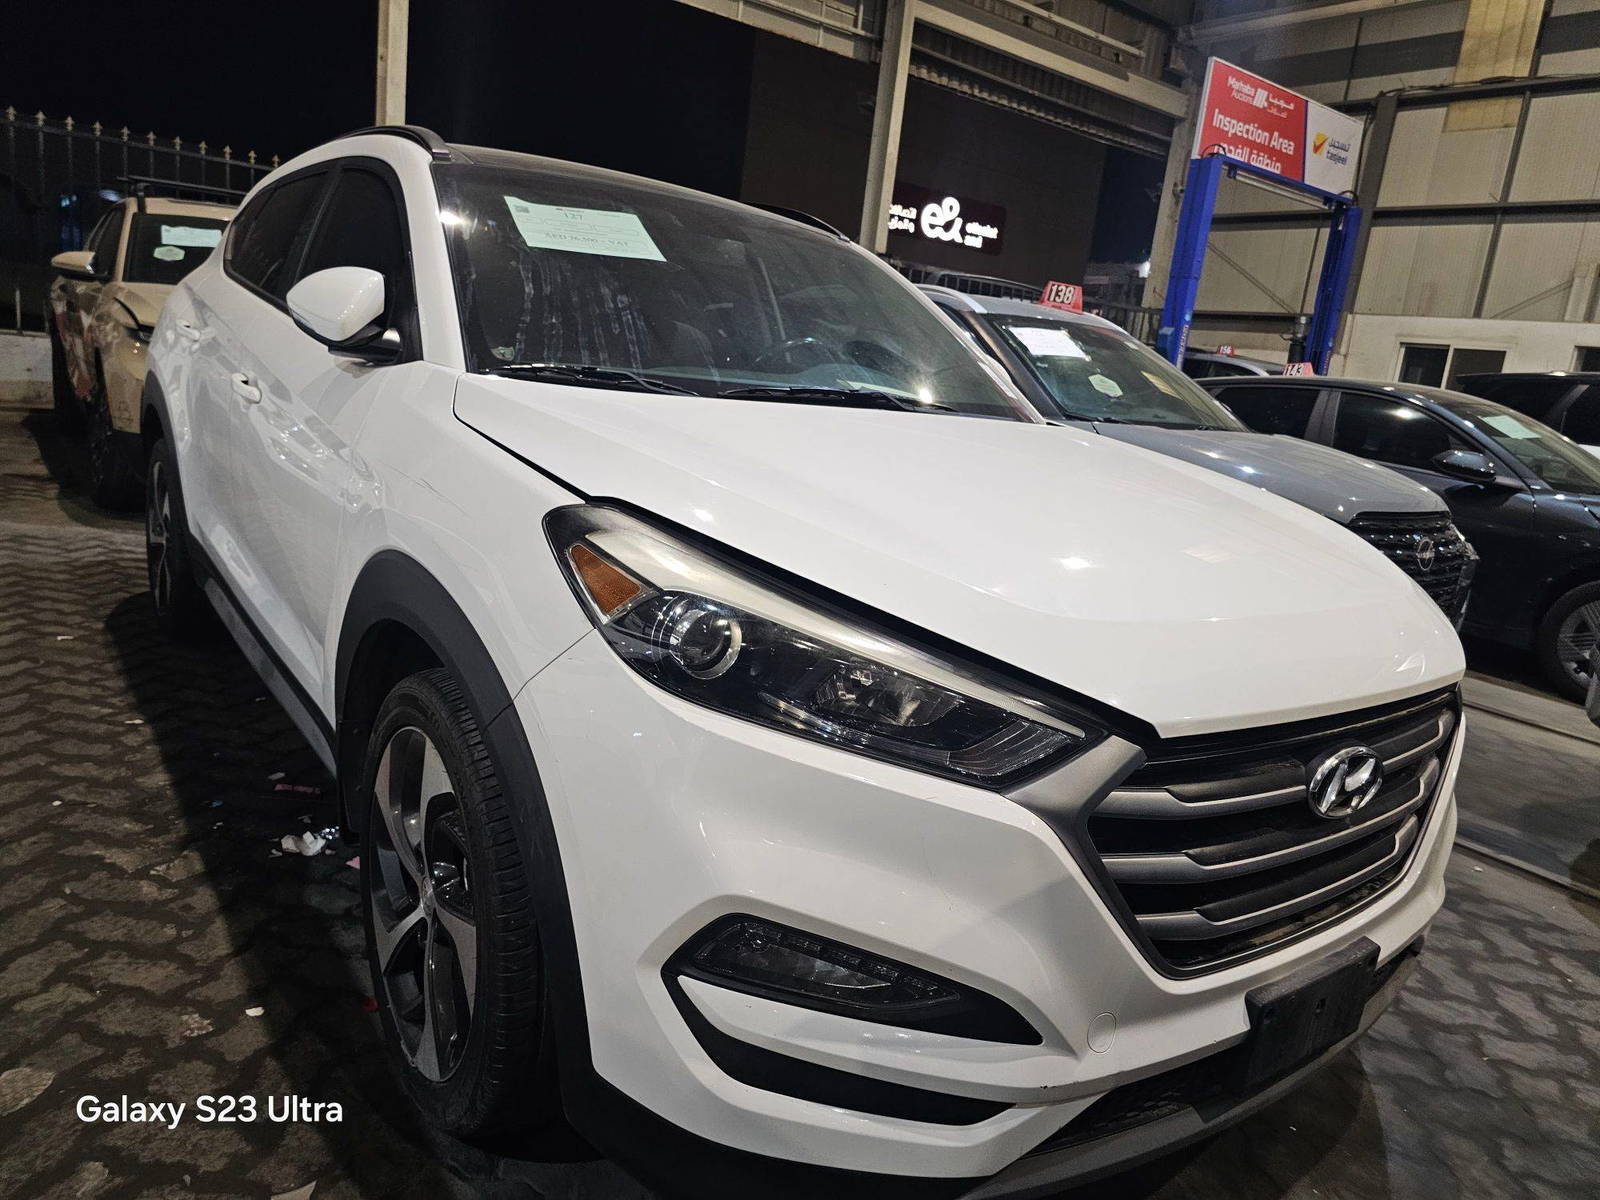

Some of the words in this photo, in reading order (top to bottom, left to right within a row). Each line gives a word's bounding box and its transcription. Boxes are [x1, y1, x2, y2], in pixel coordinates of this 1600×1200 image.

[1213, 108, 1270, 146] Inspection
[1270, 131, 1295, 156] Area
[1050, 284, 1075, 305] 138
[1286, 362, 1304, 376] 143
